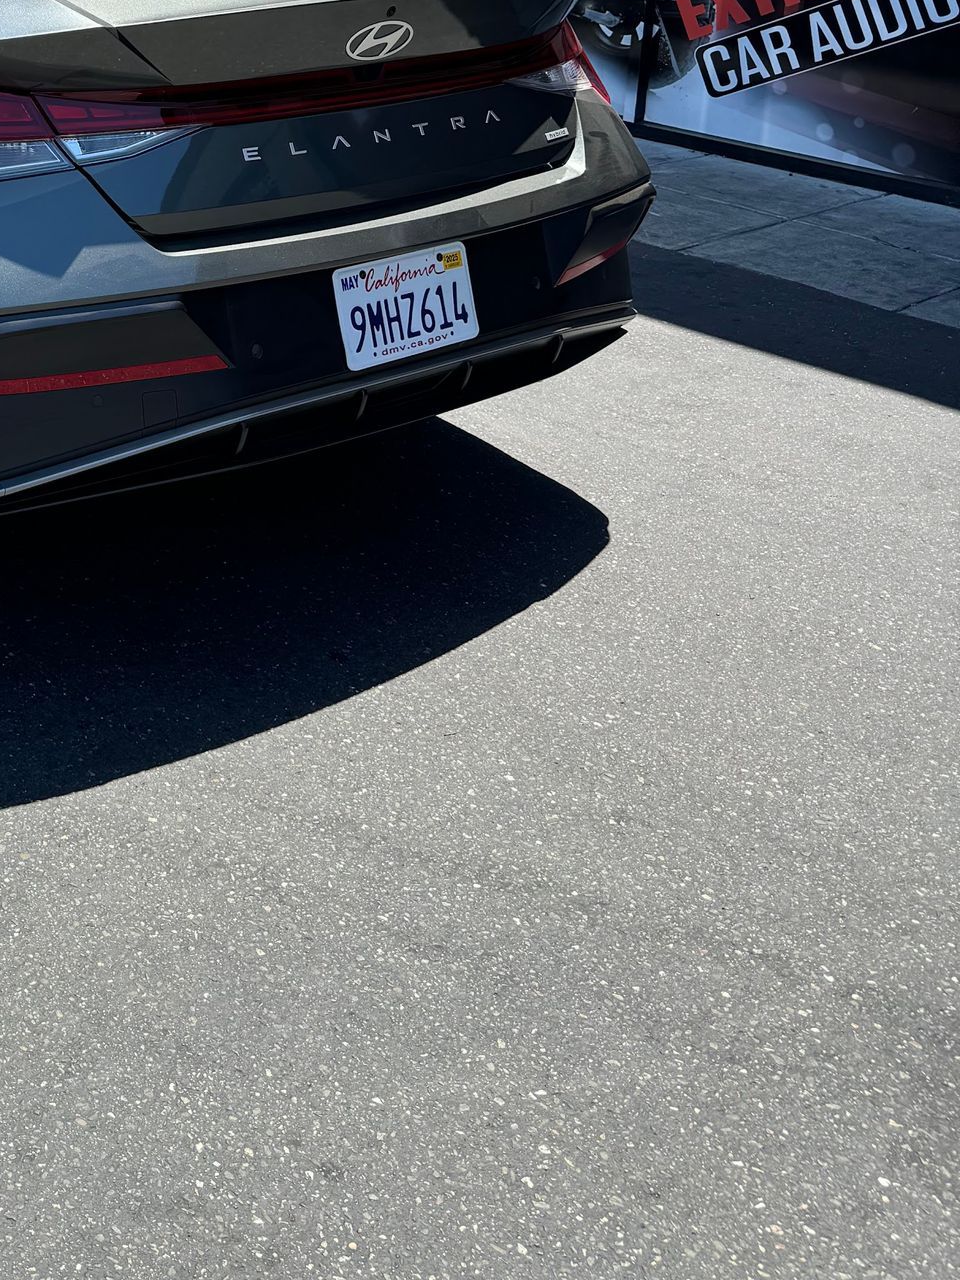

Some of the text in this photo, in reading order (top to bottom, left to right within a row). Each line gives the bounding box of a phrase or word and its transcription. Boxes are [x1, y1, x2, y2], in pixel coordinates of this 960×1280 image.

[702, 25, 800, 92] CAR
[242, 110, 501, 162] ELANTRA
[341, 275, 360, 292] MAY
[364, 258, 445, 293] California
[350, 281, 469, 354] 9MHZ614
[381, 332, 449, 357] dmv.ca.gov
